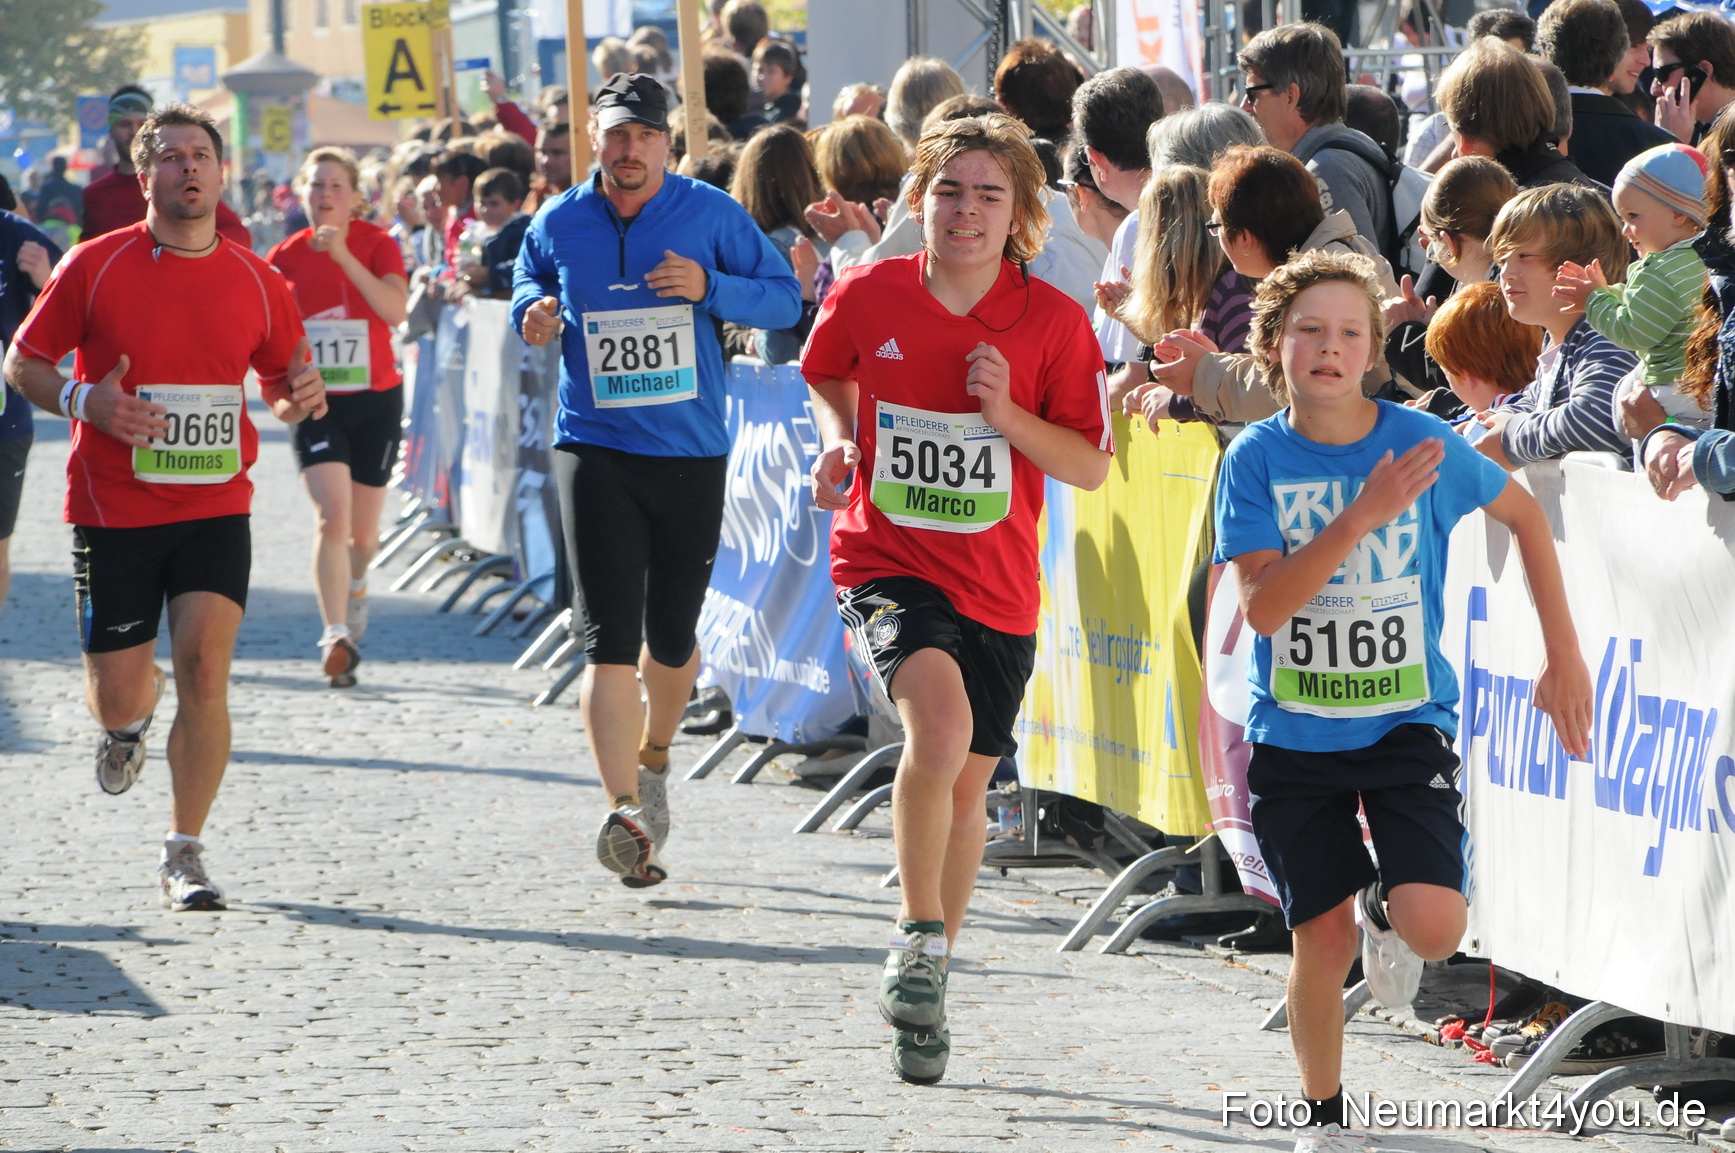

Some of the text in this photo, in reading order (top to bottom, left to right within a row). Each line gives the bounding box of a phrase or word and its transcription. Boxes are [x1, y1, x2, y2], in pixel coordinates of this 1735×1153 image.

[369, 5, 431, 29] Block
[384, 38, 425, 94] A
[599, 318, 646, 329] PFLEIDERER
[599, 332, 680, 373] 2881
[875, 350, 904, 360] adidas
[607, 370, 680, 395] Michael
[153, 391, 201, 403] PFLEIDERER
[895, 415, 950, 433] PFLEIDERER
[895, 426, 950, 439] AKTIENGESELLSCHAFT
[963, 425, 998, 436] BOCK
[153, 449, 223, 470] Thomas
[891, 436, 996, 488] 5034
[905, 486, 976, 517] Marco
[1307, 595, 1355, 608] EIDERER
[1371, 592, 1409, 608] BOCK
[1304, 606, 1356, 615] ENGESELLSCHAFT
[1290, 615, 1407, 668] 5168
[1298, 669, 1401, 700] Michael
